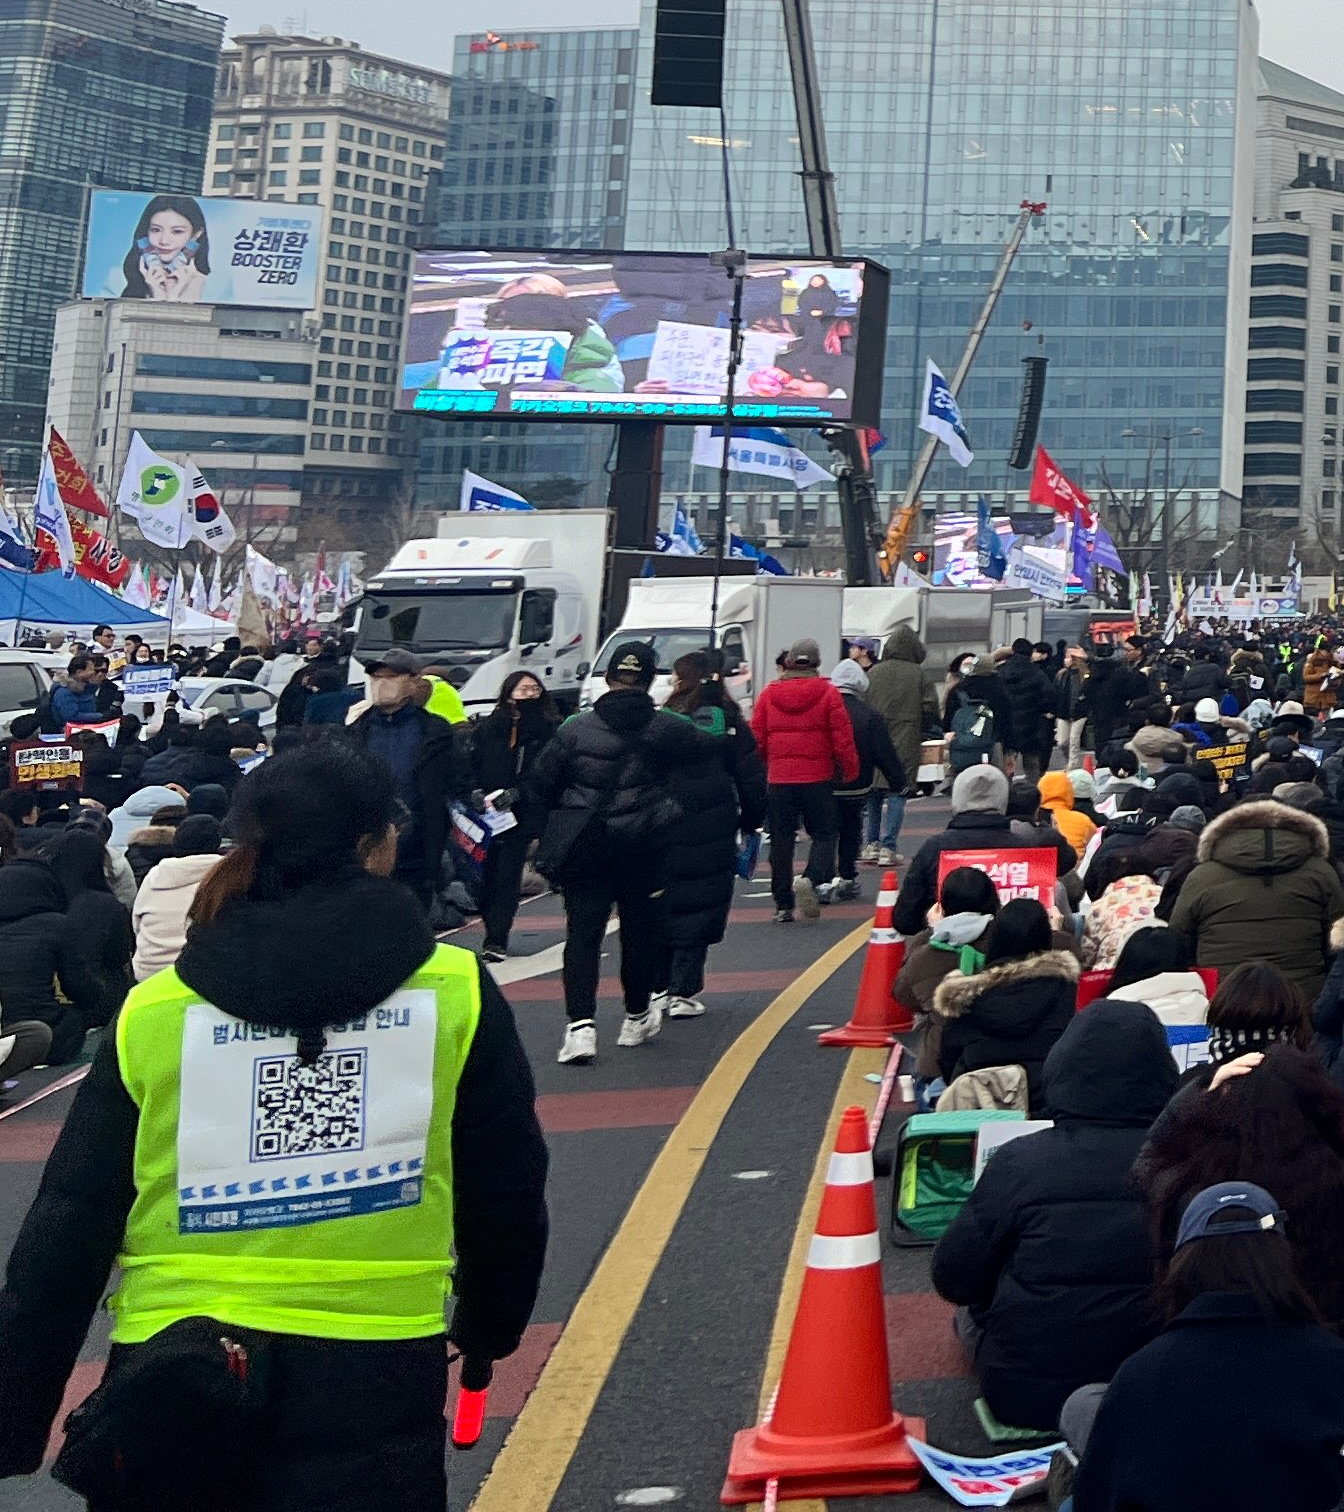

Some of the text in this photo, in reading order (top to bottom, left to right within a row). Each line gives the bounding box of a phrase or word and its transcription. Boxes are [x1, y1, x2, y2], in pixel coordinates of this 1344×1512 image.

[231, 252, 303, 271] BOOSTER
[257, 269, 299, 285] ZERO
[481, 361, 548, 385] 파면
[374, 1007, 411, 1030] 안내
